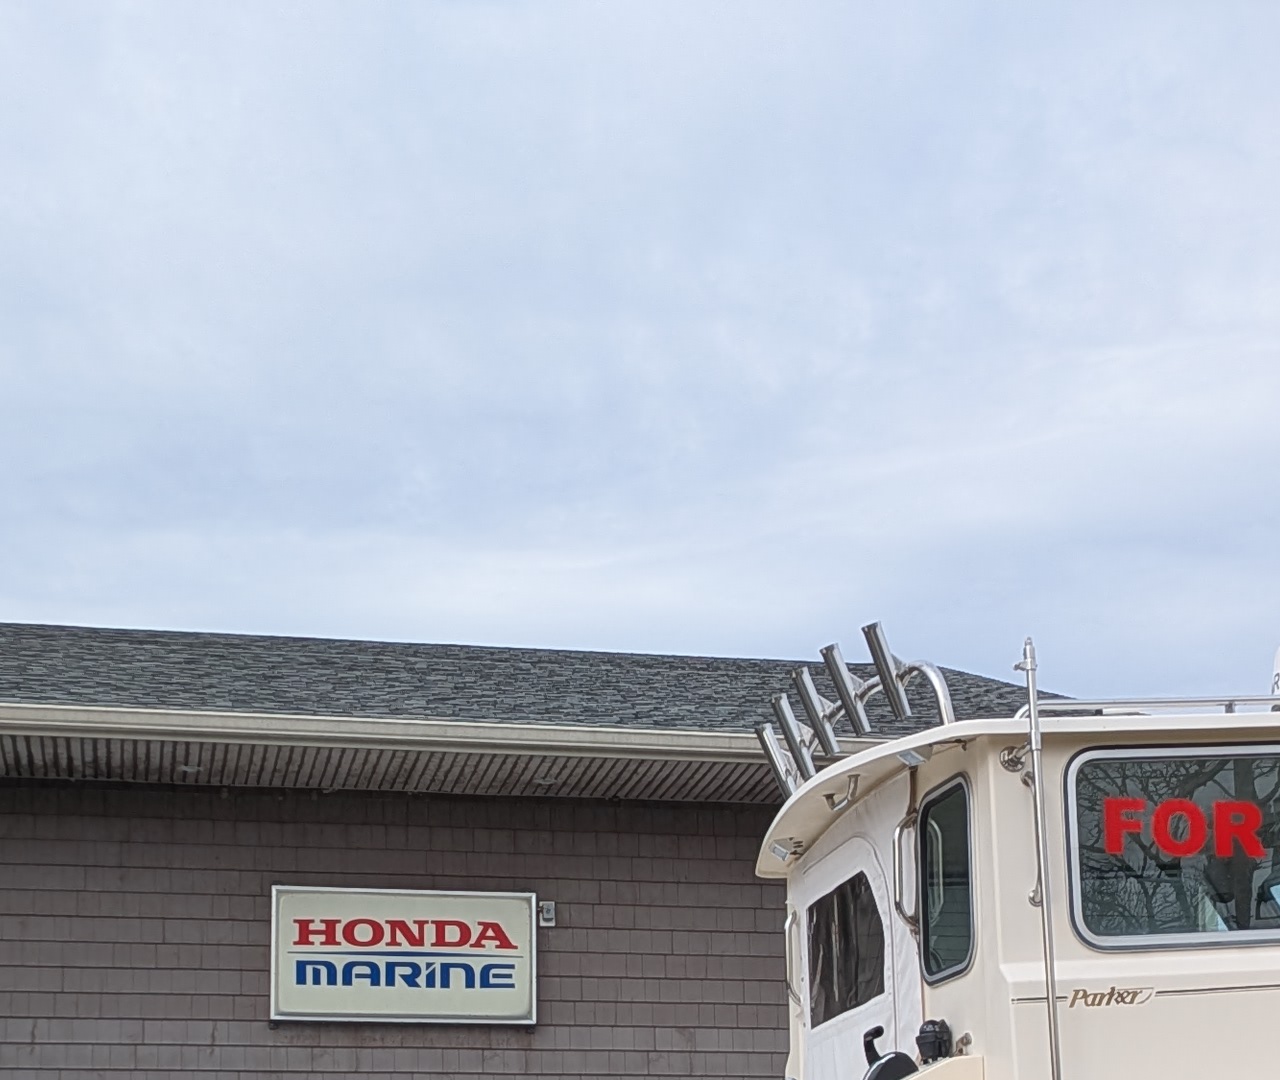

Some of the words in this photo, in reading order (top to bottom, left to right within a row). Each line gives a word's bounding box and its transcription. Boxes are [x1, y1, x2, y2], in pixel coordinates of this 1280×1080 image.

[1104, 796, 1265, 857] FOR
[293, 918, 519, 950] HONDA
[1068, 986, 1144, 1009] Parker
